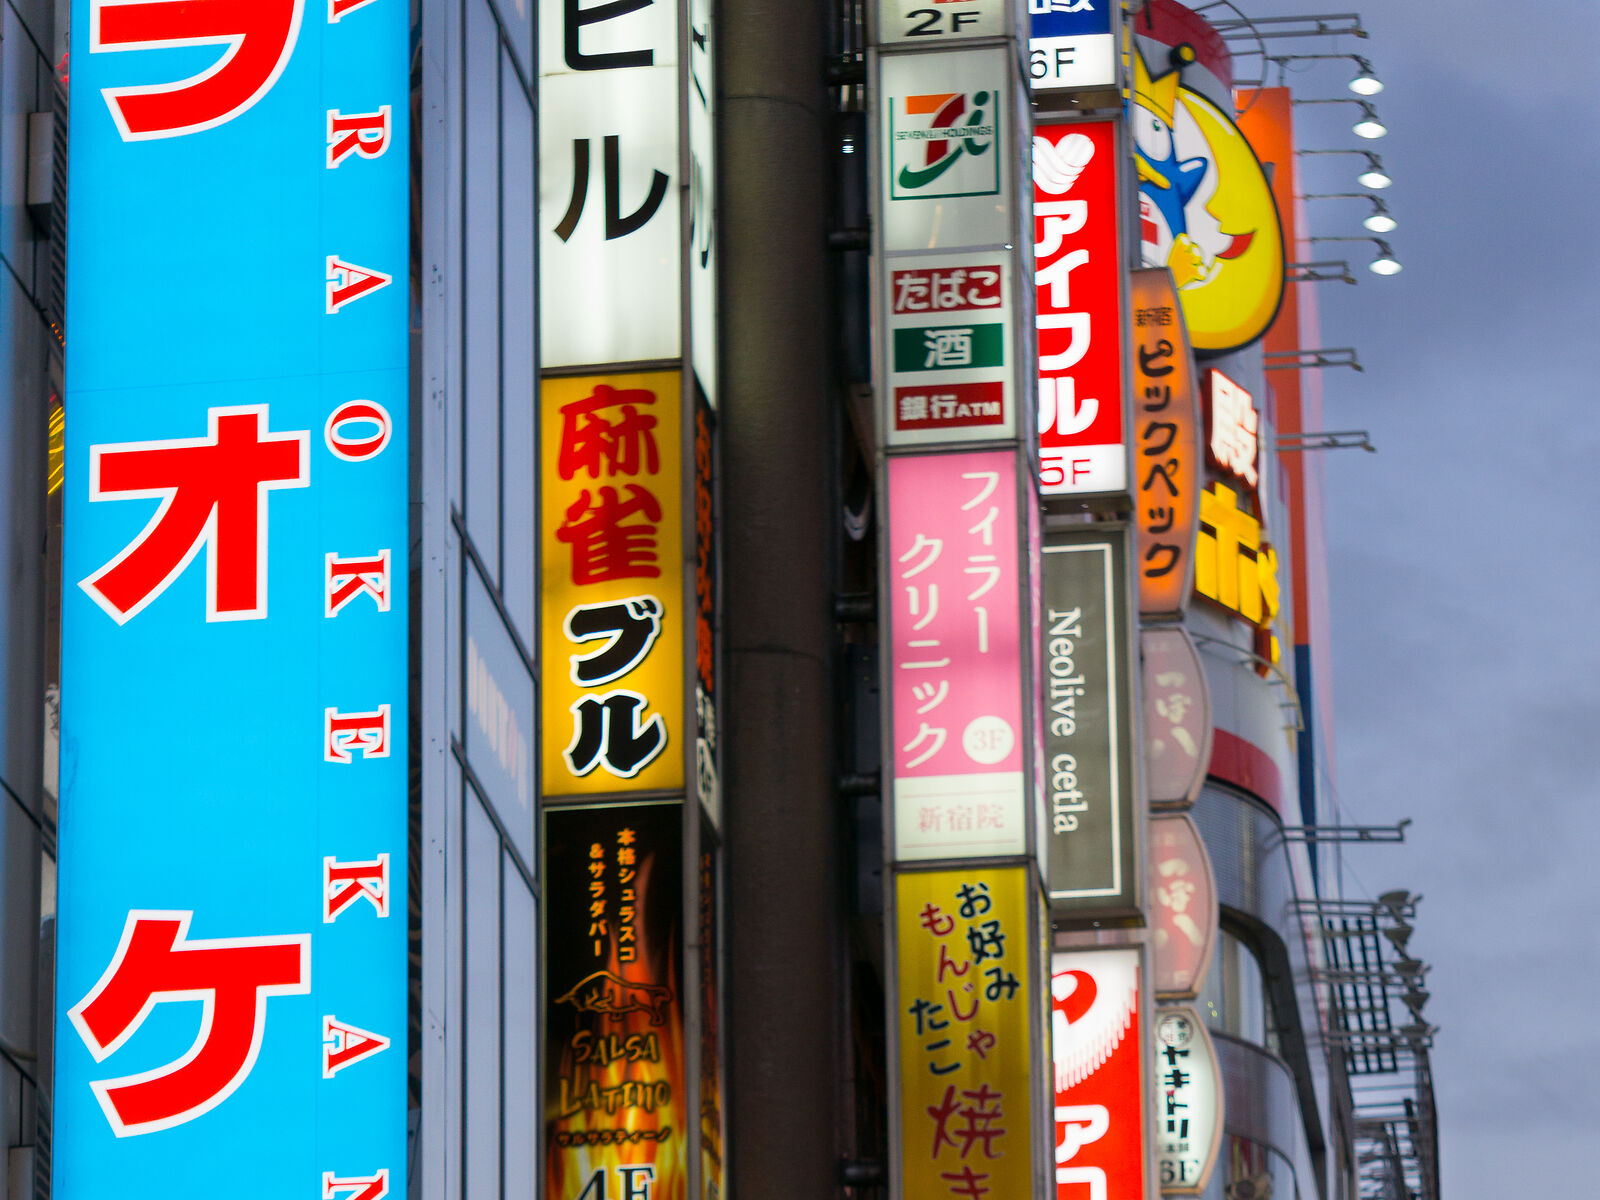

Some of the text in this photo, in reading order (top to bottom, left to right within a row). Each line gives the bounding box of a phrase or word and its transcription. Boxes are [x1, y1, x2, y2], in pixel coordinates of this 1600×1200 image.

[904, 8, 980, 37] 2F
[896, 269, 1001, 311] たばこ
[924, 328, 973, 368] 酒
[900, 394, 1001, 421] 銀行ATM
[1039, 457, 1091, 486] 5F
[961, 471, 1001, 653] フィラー
[899, 533, 951, 769] クリニック
[973, 729, 1004, 752] 3F
[1048, 607, 1089, 835] Neolive cetla
[917, 803, 1006, 833] 新宿院
[616, 827, 637, 964] 本格シュラスコ
[956, 881, 1020, 1002] お好み
[920, 903, 997, 1060] もんじゃ
[571, 1030, 660, 1064] SALSA
[909, 999, 962, 1077] たこ
[559, 1076, 672, 1119] LATINO
